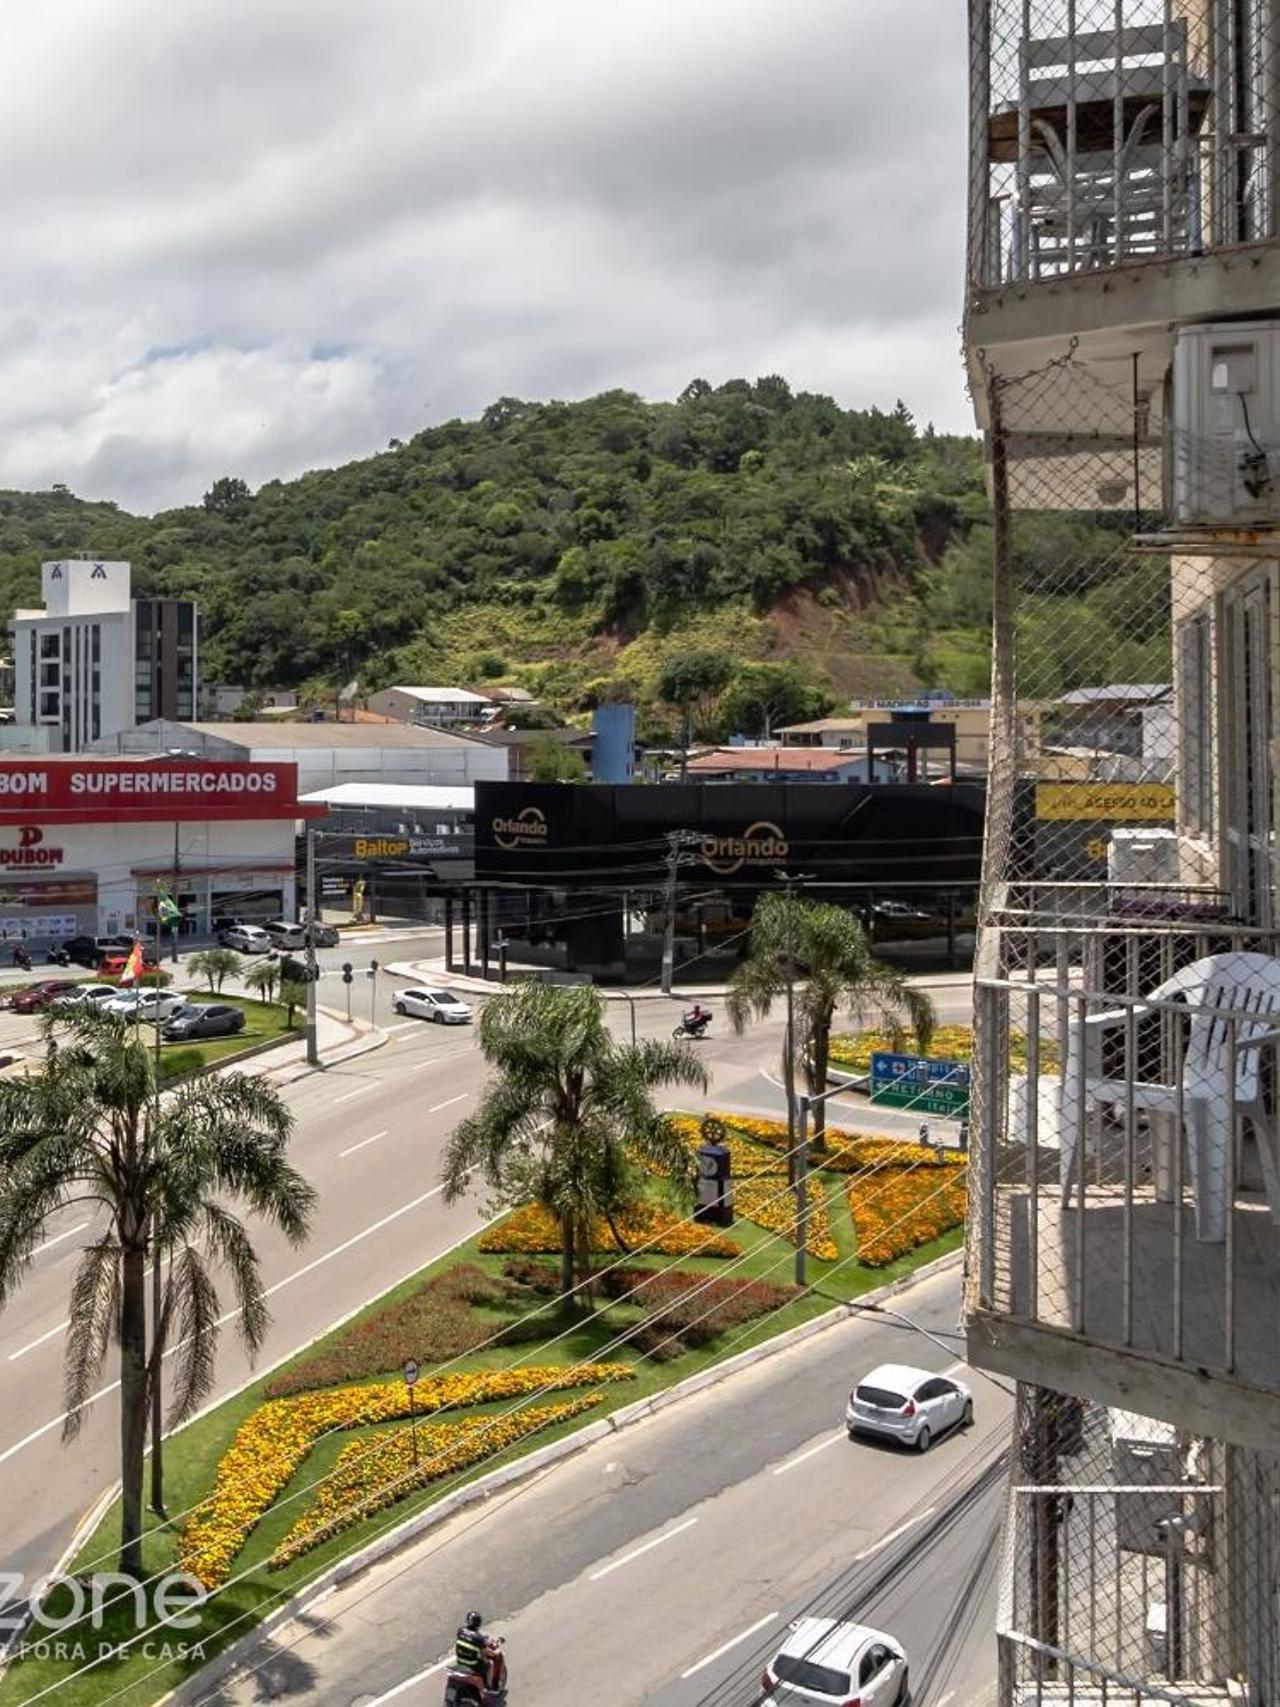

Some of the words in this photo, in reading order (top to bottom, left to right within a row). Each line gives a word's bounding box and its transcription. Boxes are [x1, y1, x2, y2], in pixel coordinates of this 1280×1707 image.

[70, 772, 277, 793] SUPERMERCADOS
[492, 818, 548, 836] Orlando
[701, 837, 789, 857] Orlando
